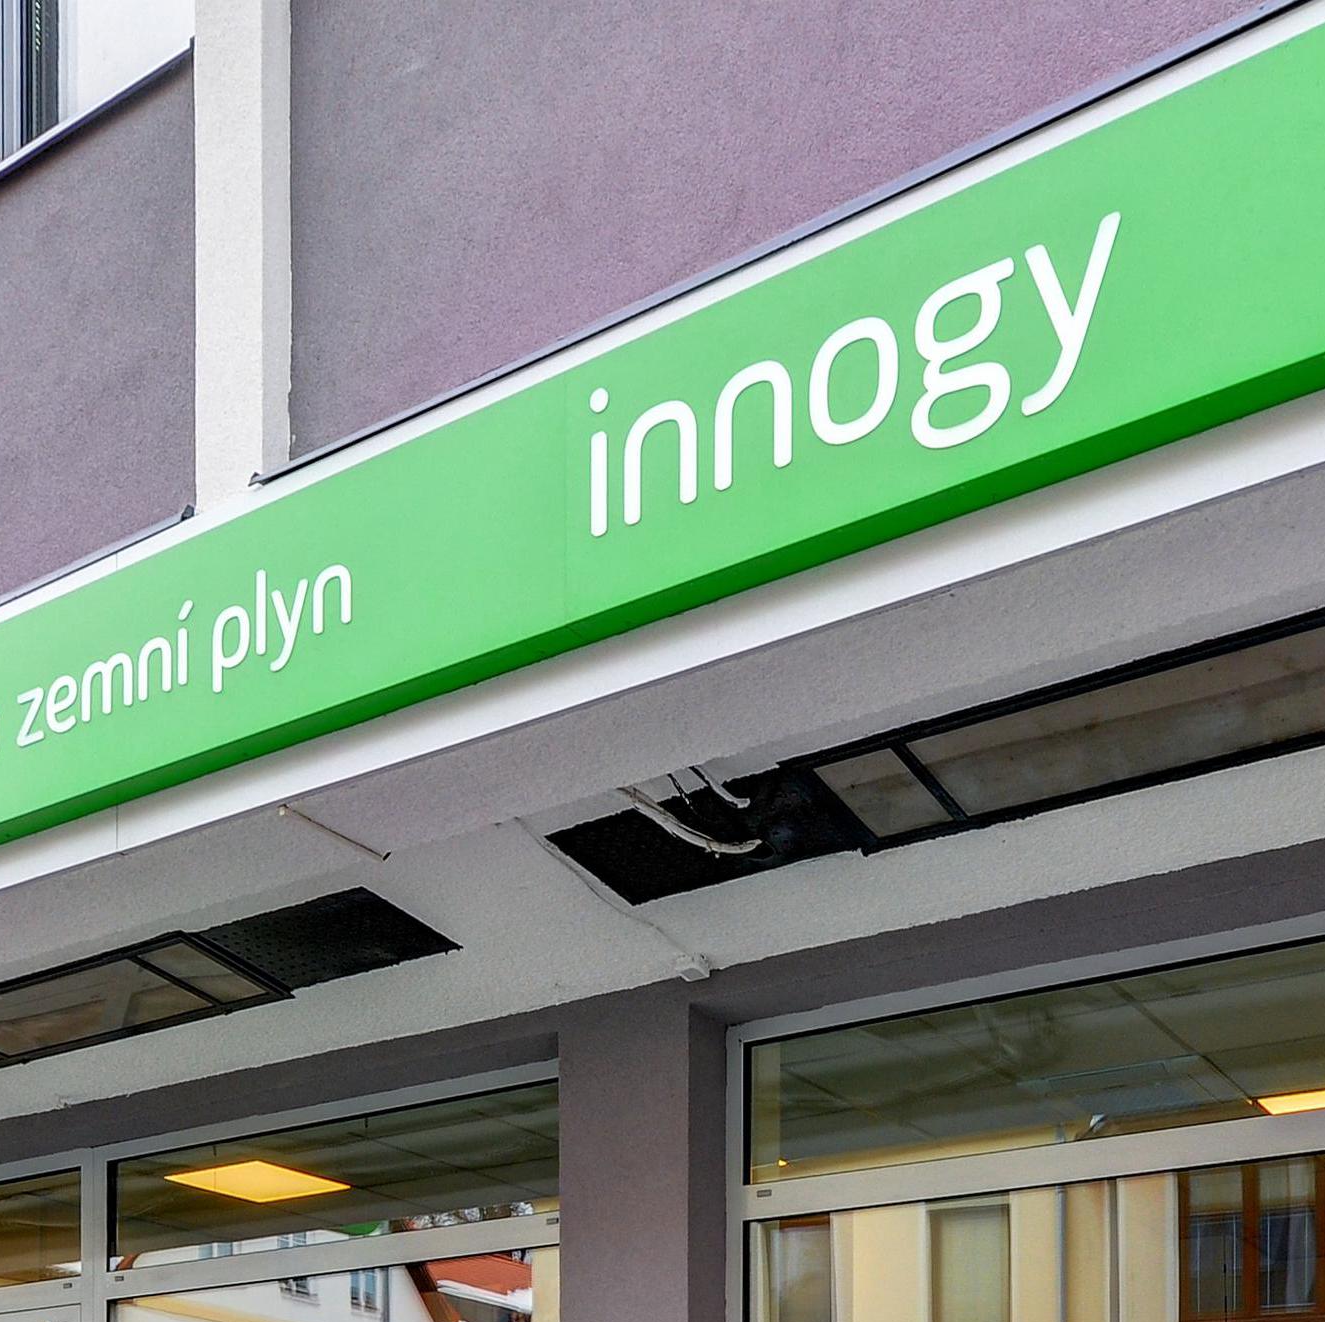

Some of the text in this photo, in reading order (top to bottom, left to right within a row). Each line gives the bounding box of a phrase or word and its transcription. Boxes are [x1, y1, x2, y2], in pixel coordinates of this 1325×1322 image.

[589, 210, 1122, 538] innogy
[15, 599, 194, 747] zemní
[210, 562, 354, 694] plyn
